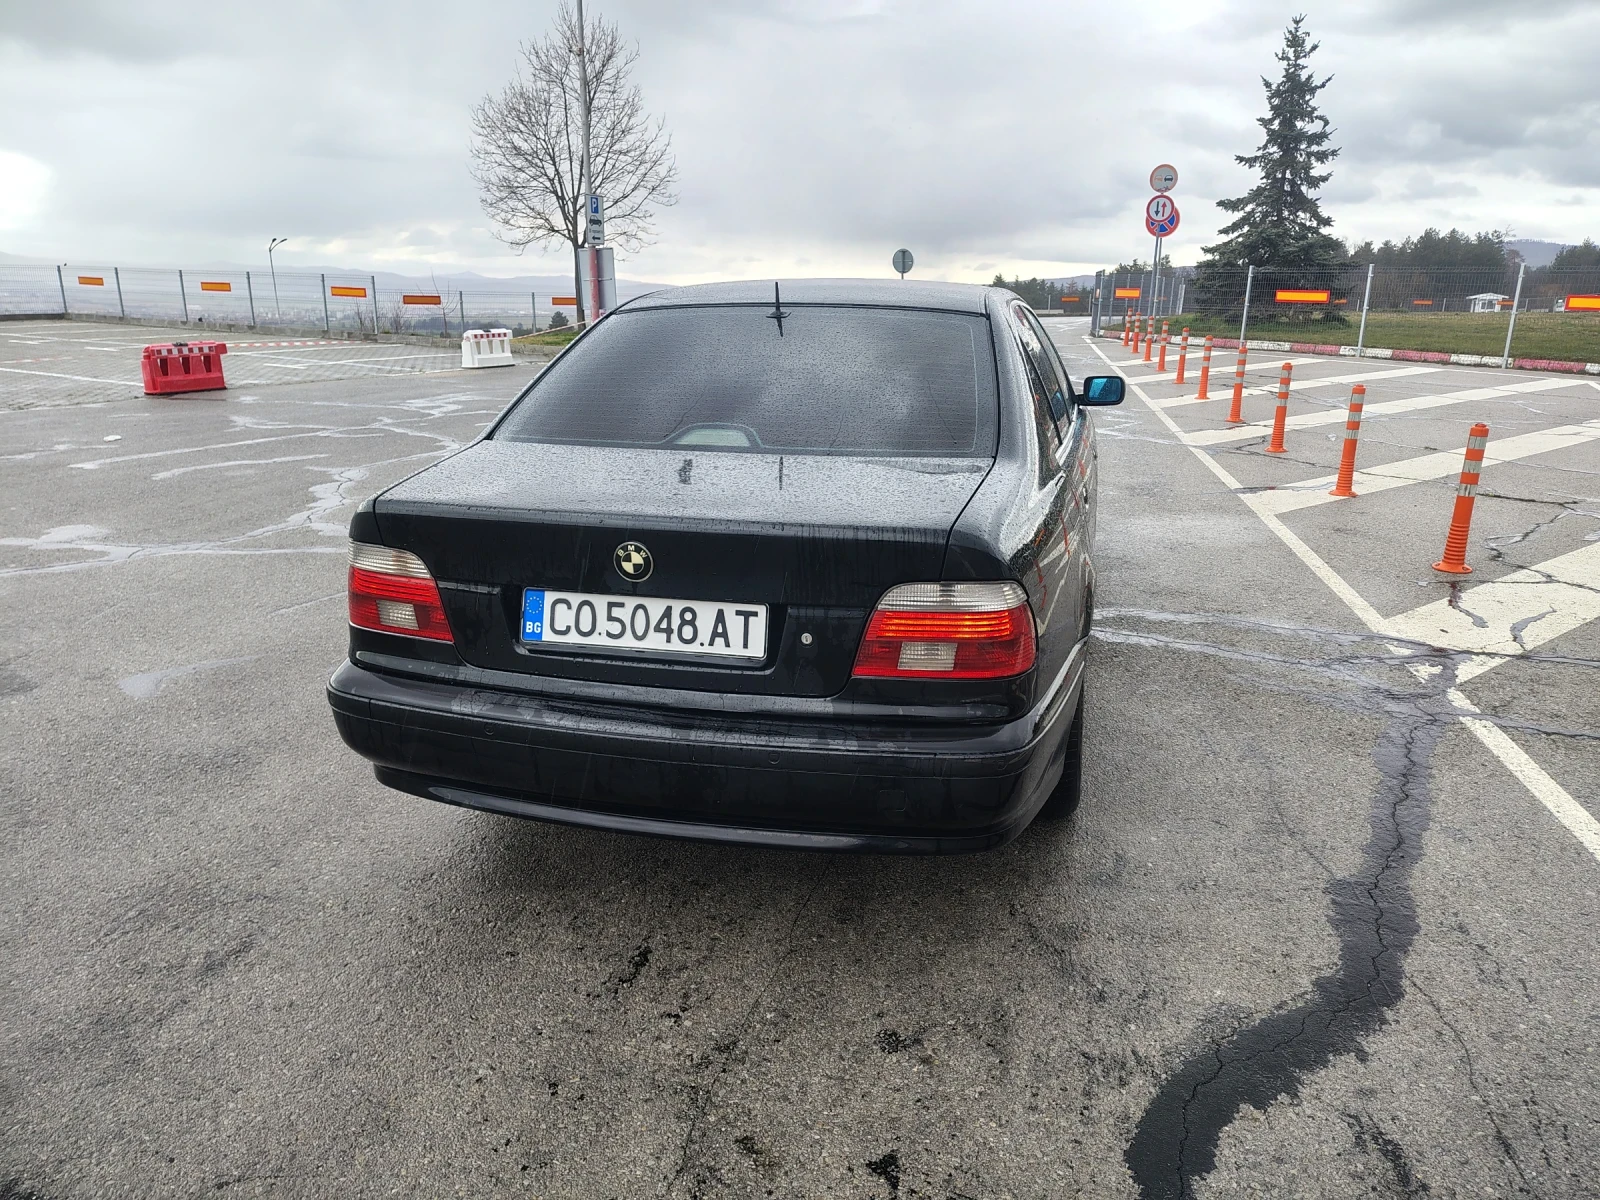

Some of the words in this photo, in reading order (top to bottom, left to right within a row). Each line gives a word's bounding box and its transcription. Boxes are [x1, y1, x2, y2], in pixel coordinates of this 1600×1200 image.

[591, 198, 598, 213] P
[617, 545, 648, 558] BMW
[525, 621, 542, 634] BG
